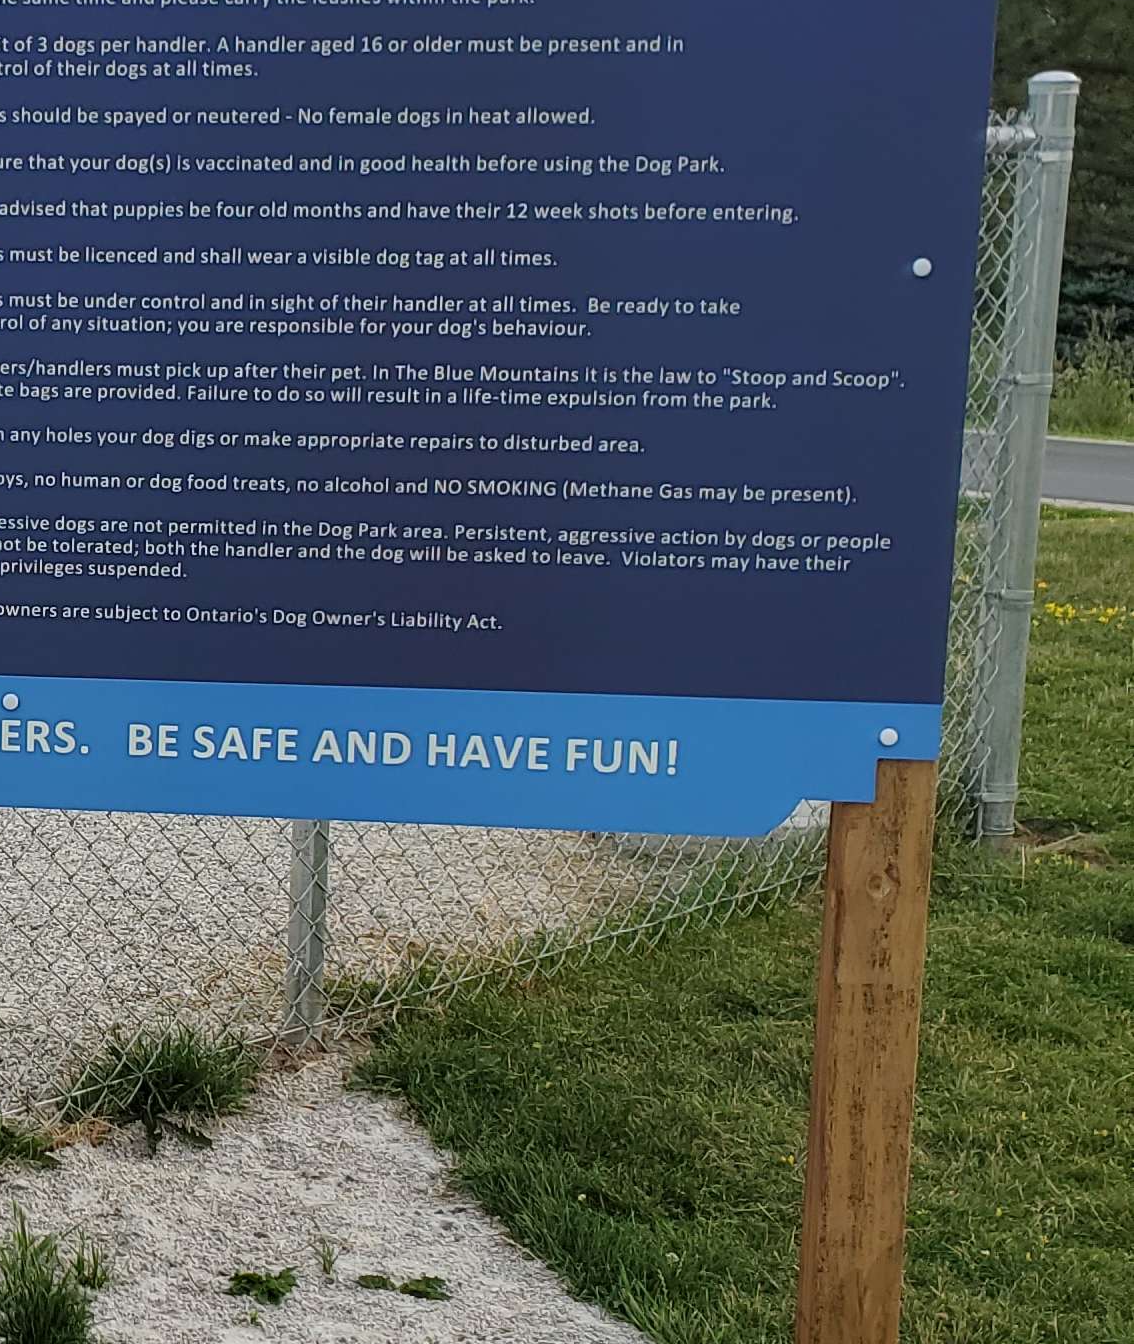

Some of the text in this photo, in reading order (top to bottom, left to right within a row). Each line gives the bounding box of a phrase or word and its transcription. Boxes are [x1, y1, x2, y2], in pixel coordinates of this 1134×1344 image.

[14, 36, 33, 52] of
[38, 37, 47, 52] 3
[54, 36, 94, 56] dogs
[101, 41, 130, 56] per
[137, 36, 210, 52] handler.
[217, 37, 229, 52] A
[236, 36, 306, 52] handler
[311, 36, 354, 56] aged
[362, 36, 382, 52] 16
[388, 40, 407, 52] or
[414, 36, 462, 52] older
[468, 38, 514, 52] must
[520, 36, 542, 52] be
[549, 38, 620, 55] present
[626, 35, 660, 52] and
[668, 36, 683, 52] in
[34, 60, 52, 75] of
[58, 60, 100, 76] their
[106, 60, 147, 79] dogs
[153, 63, 170, 76] at
[176, 60, 196, 76] all
[202, 61, 257, 76] times.
[10, 248, 52, 261] must
[59, 246, 79, 262] be
[86, 247, 157, 263] licenced
[164, 248, 194, 263] and
[201, 248, 241, 263] shall
[248, 252, 292, 264] wear
[298, 252, 306, 264] a
[313, 248, 370, 264] visible
[377, 249, 409, 268] dog
[416, 251, 444, 268] tag
[450, 251, 467, 265] at
[474, 249, 494, 265] all
[501, 250, 556, 265] times.
[35, 475, 55, 486] no
[62, 472, 120, 487] human
[127, 477, 145, 488] or
[150, 474, 182, 492] dog
[188, 474, 227, 489] food
[233, 477, 290, 493] treats,
[297, 480, 318, 491] no
[325, 477, 389, 492] alcohol
[395, 478, 427, 493] and
[435, 480, 461, 494] NO
[468, 480, 556, 496] SMOKING
[563, 481, 653, 499] (Methane
[660, 484, 692, 499] Gas
[699, 488, 737, 503] may
[744, 485, 765, 500] be
[772, 486, 856, 505] present).
[1, 559, 82, 577] privileges
[89, 562, 187, 579] suspended.
[63, 607, 89, 618] are
[95, 604, 158, 622] subject
[163, 608, 180, 620] to
[187, 607, 267, 623] Ontario's
[274, 610, 306, 627] Dog
[313, 611, 385, 626] Owner's
[392, 612, 462, 631] Liability
[467, 615, 502, 629] Act.
[129, 725, 178, 756] BE
[194, 726, 298, 760] SAFE
[313, 731, 410, 764] AND
[428, 734, 549, 769] HAVE
[567, 739, 677, 774] FUN!
